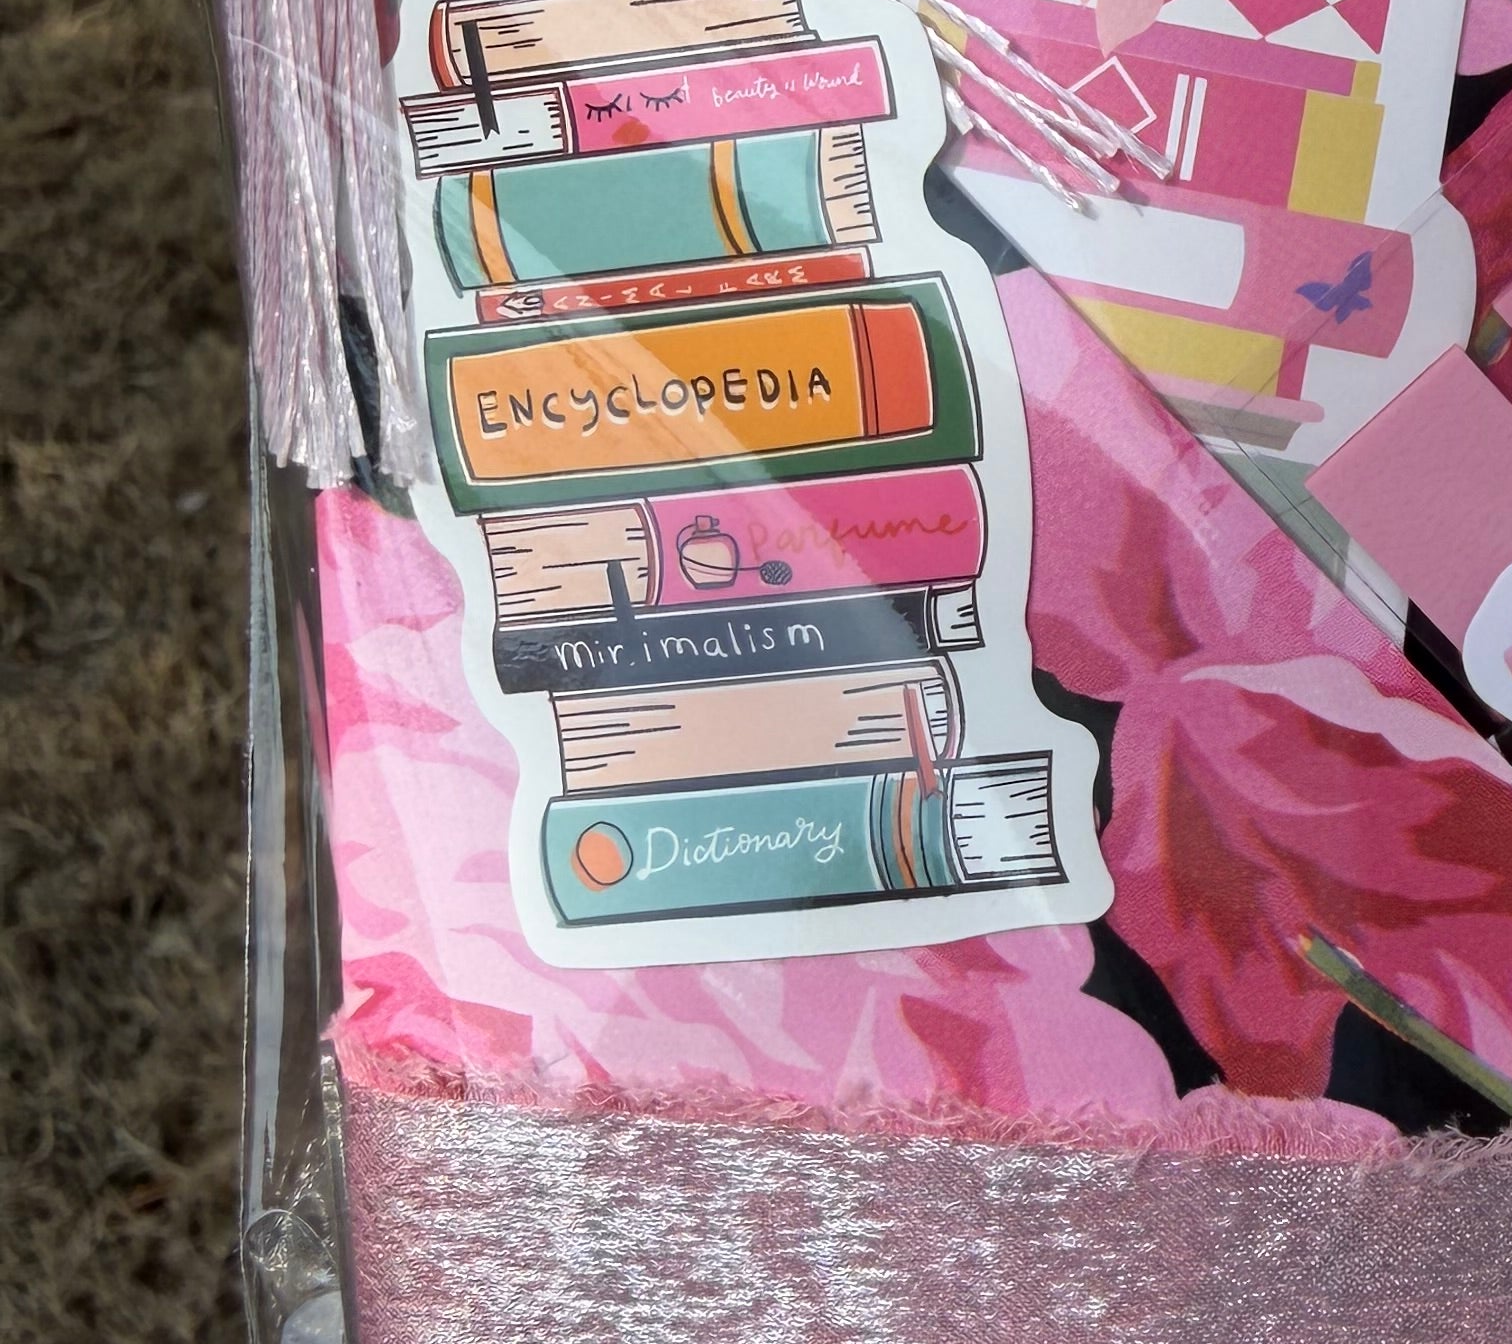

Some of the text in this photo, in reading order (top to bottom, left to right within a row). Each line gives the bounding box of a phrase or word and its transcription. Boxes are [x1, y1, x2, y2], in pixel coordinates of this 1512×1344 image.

[551, 264, 809, 311] ANIMAL FARM
[476, 365, 833, 441] ENCYCLOPEDIA
[636, 816, 845, 881] Dictionary
